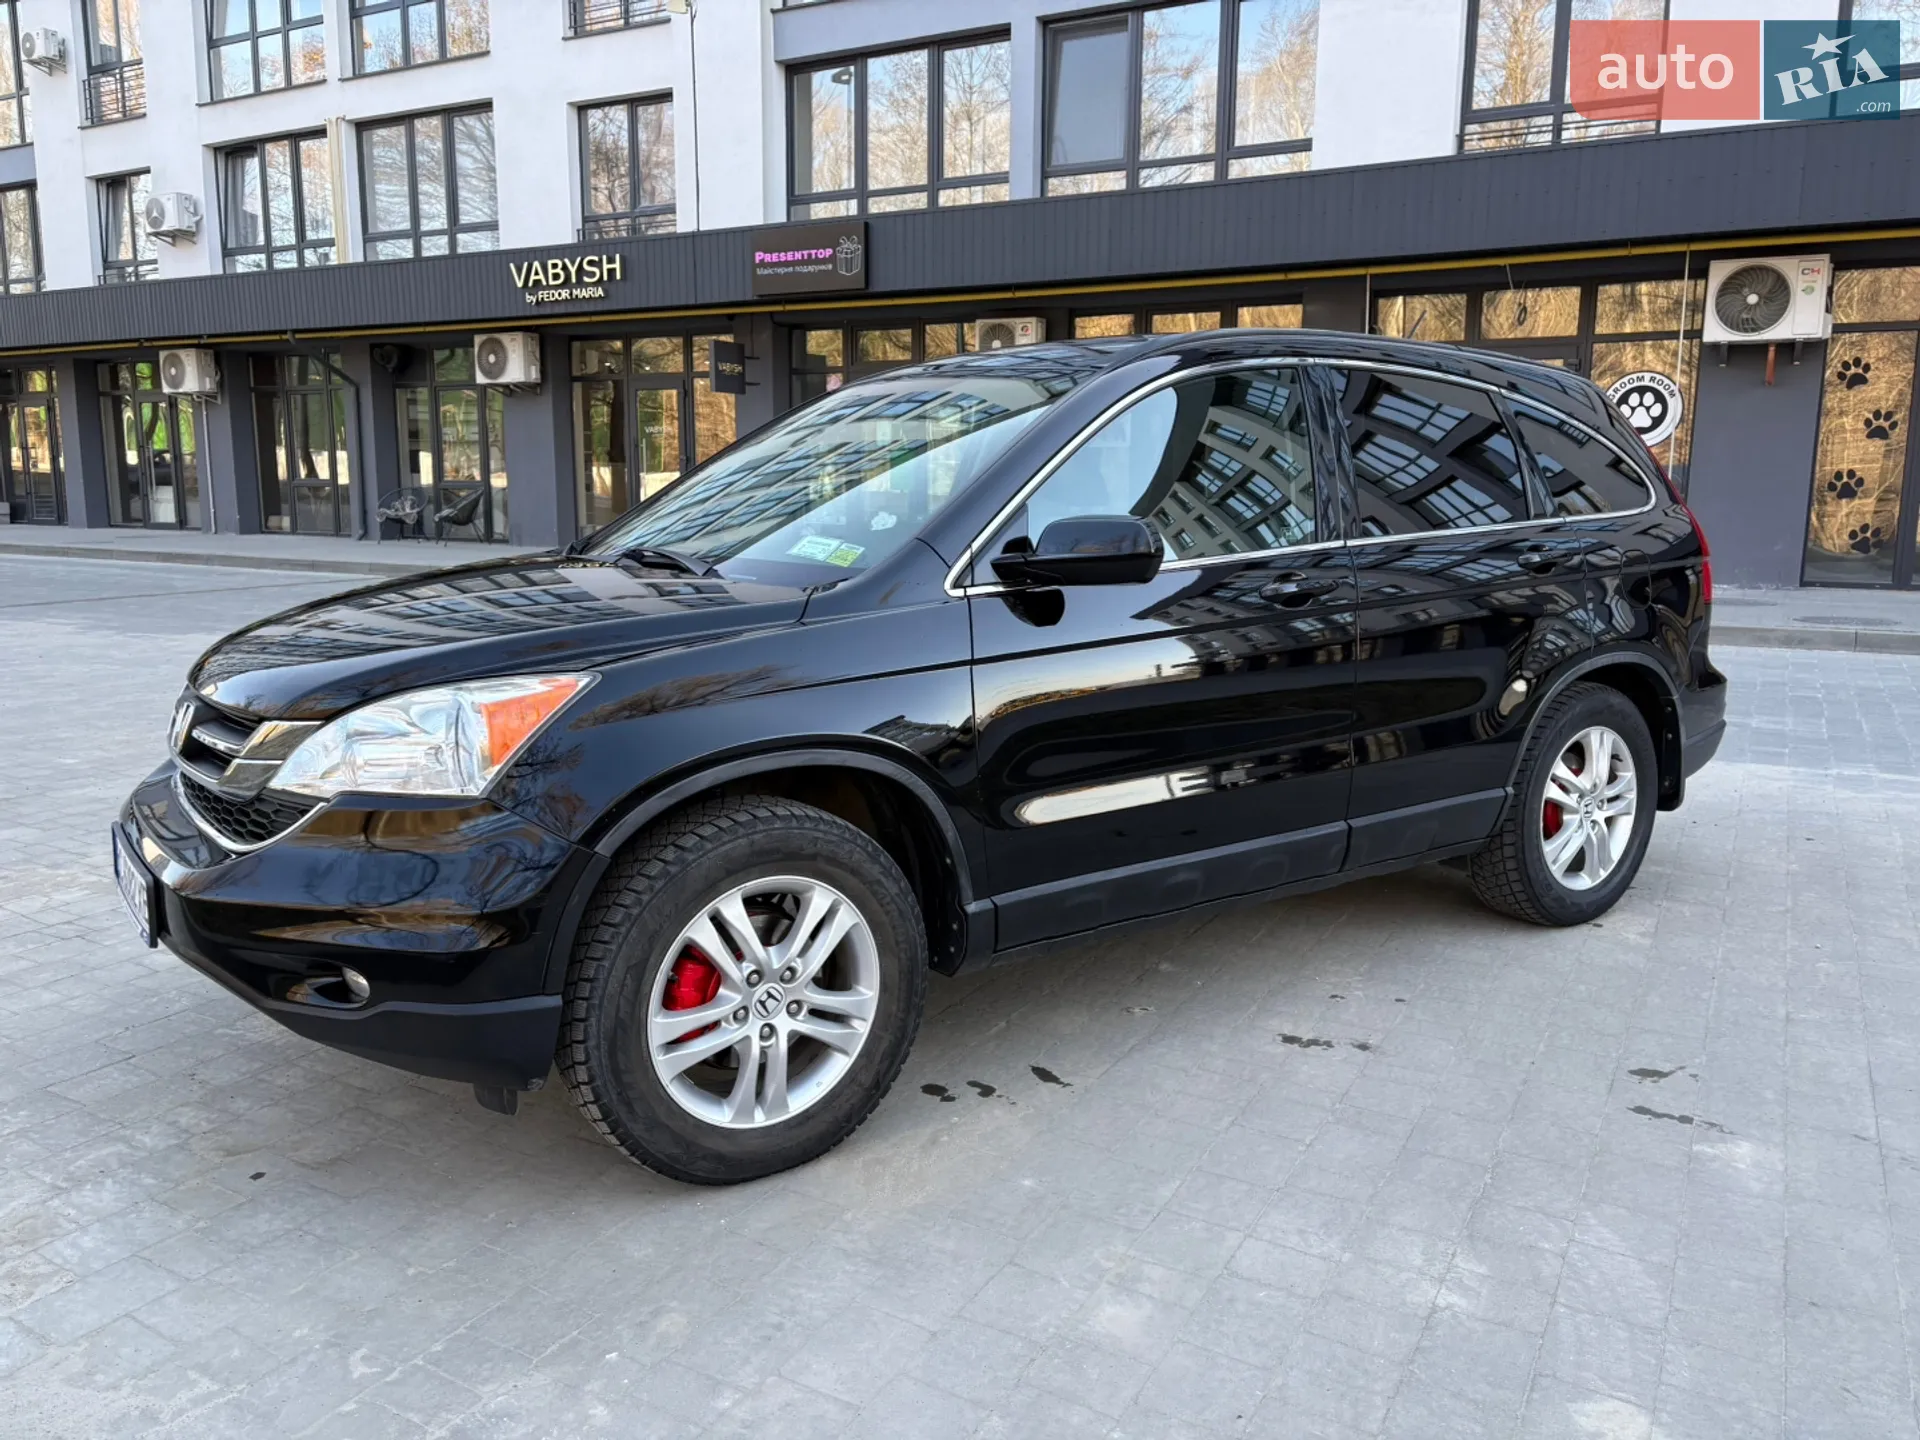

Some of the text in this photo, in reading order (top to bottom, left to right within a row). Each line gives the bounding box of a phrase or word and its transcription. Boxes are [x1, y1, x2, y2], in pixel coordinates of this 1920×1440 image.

[509, 253, 622, 288] VABYSH
[525, 286, 605, 306] by FEDOR MARIA
[1648, 376, 1676, 398] ROOM
